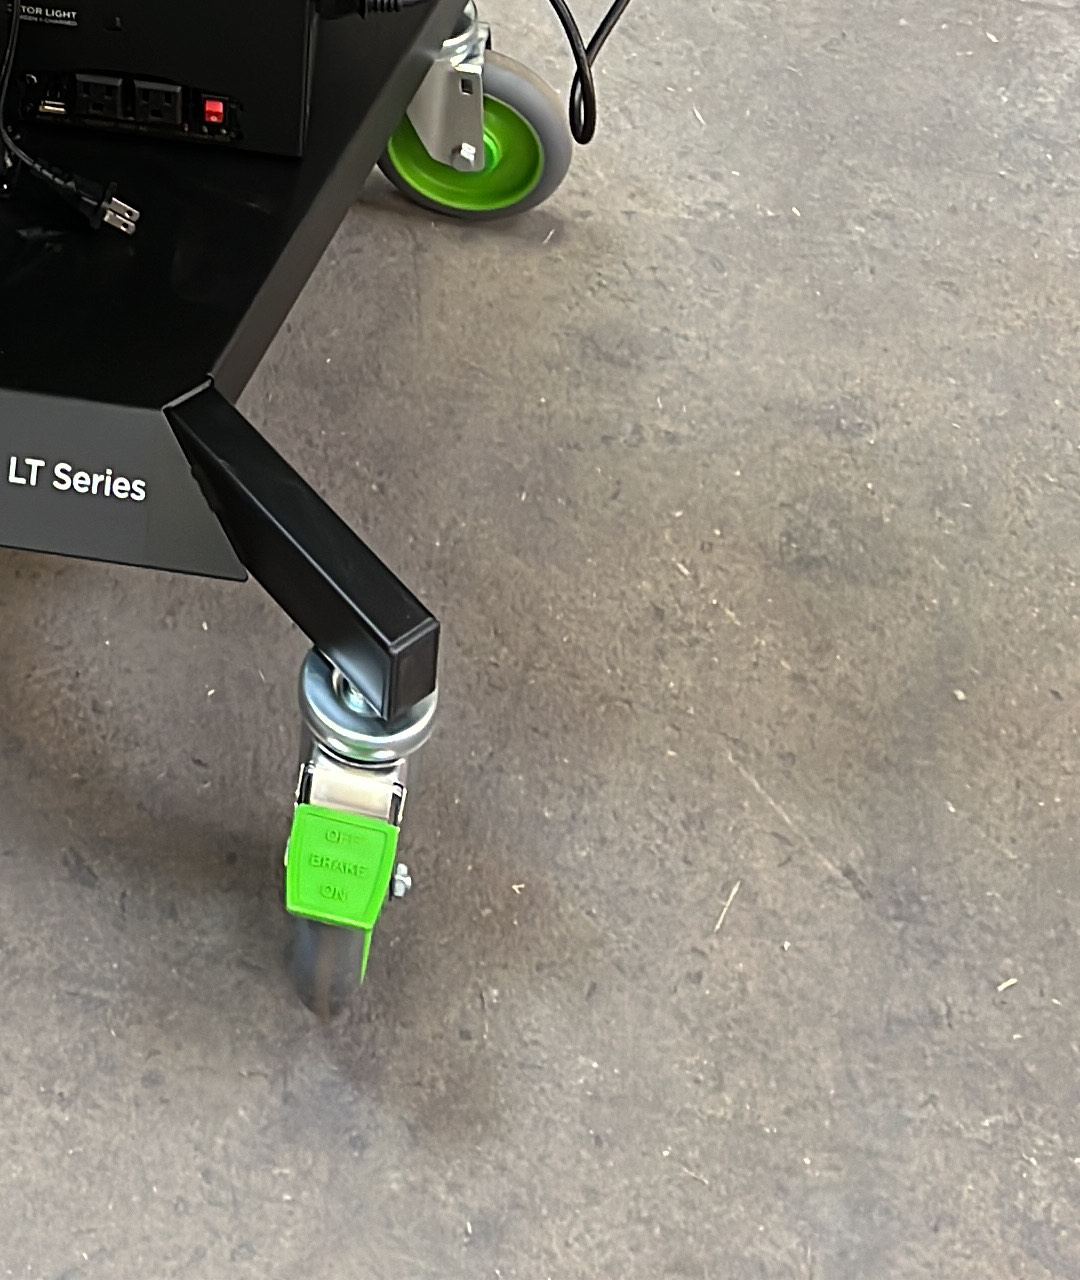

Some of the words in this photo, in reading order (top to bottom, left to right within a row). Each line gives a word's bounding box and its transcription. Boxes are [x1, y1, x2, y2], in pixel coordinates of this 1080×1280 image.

[44, 7, 77, 20] LIGHT
[7, 456, 46, 487] LT
[52, 462, 147, 502] Series
[309, 852, 367, 879] BRAKE
[320, 884, 348, 902] ON
